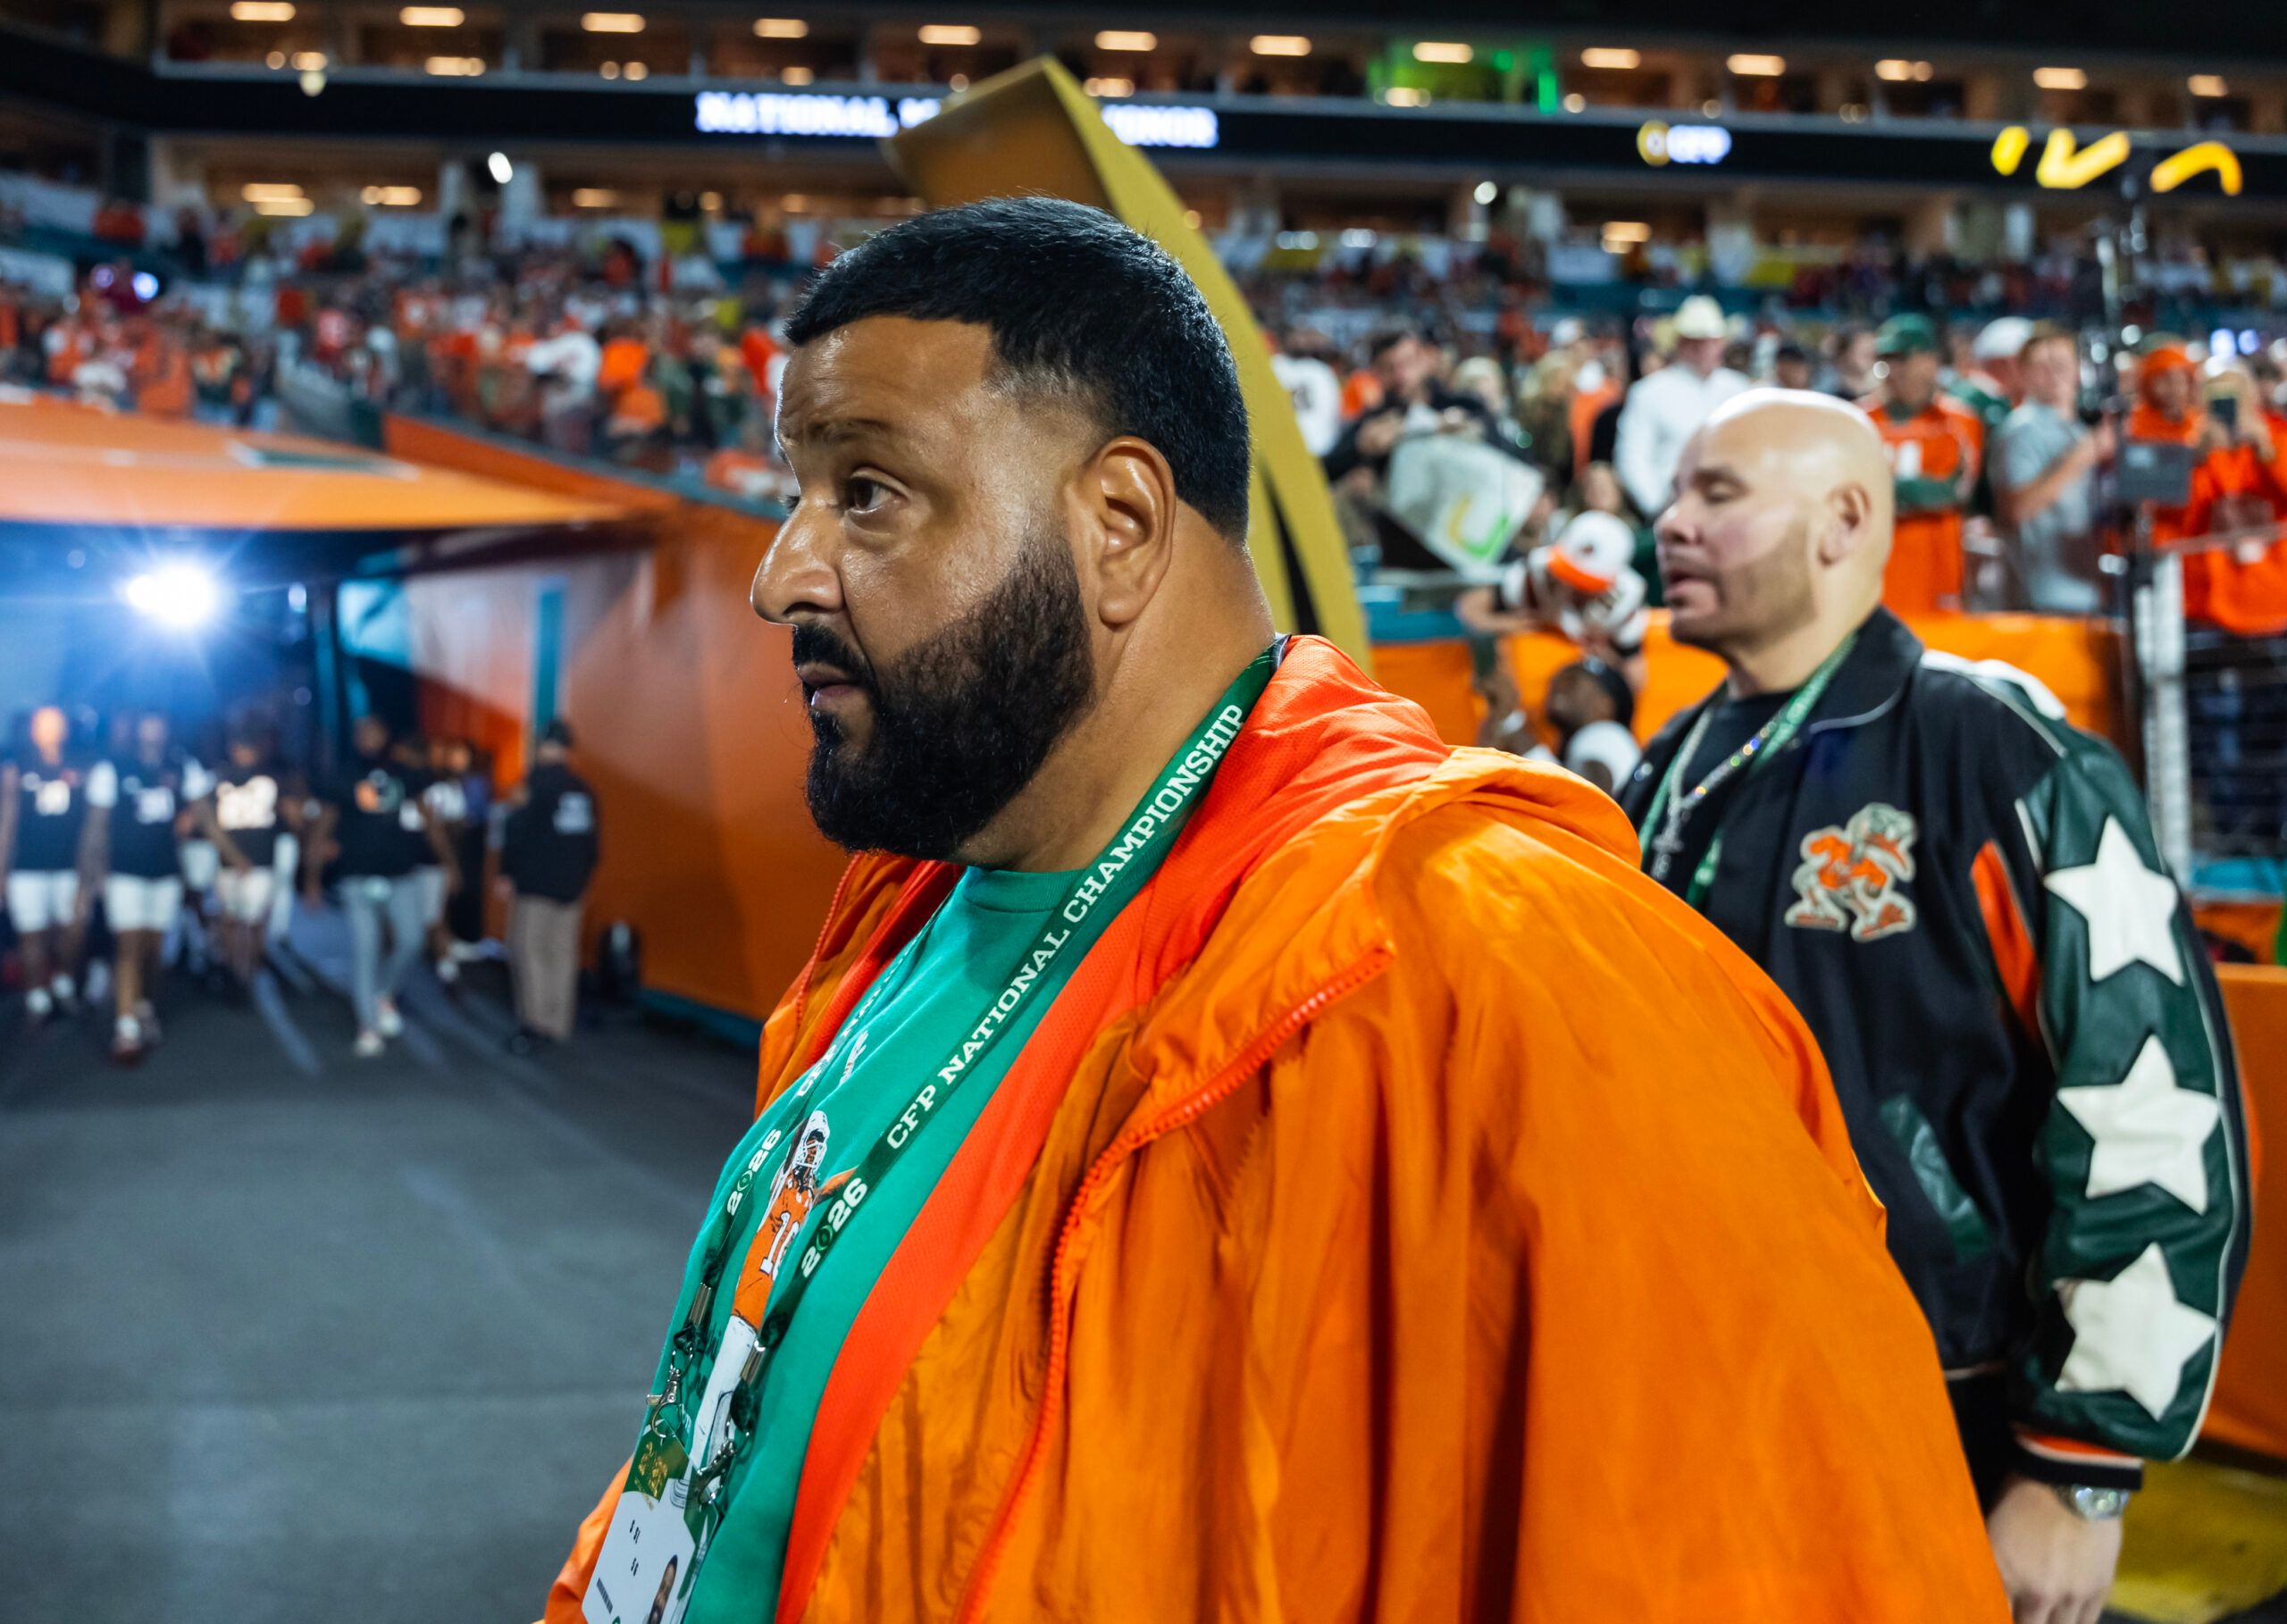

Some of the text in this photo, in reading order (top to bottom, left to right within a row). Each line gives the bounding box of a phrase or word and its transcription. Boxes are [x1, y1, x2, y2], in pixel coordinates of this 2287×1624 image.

[801, 704, 1244, 1278] 2026 CFP NATIONAL CHAMPIONSHIP
